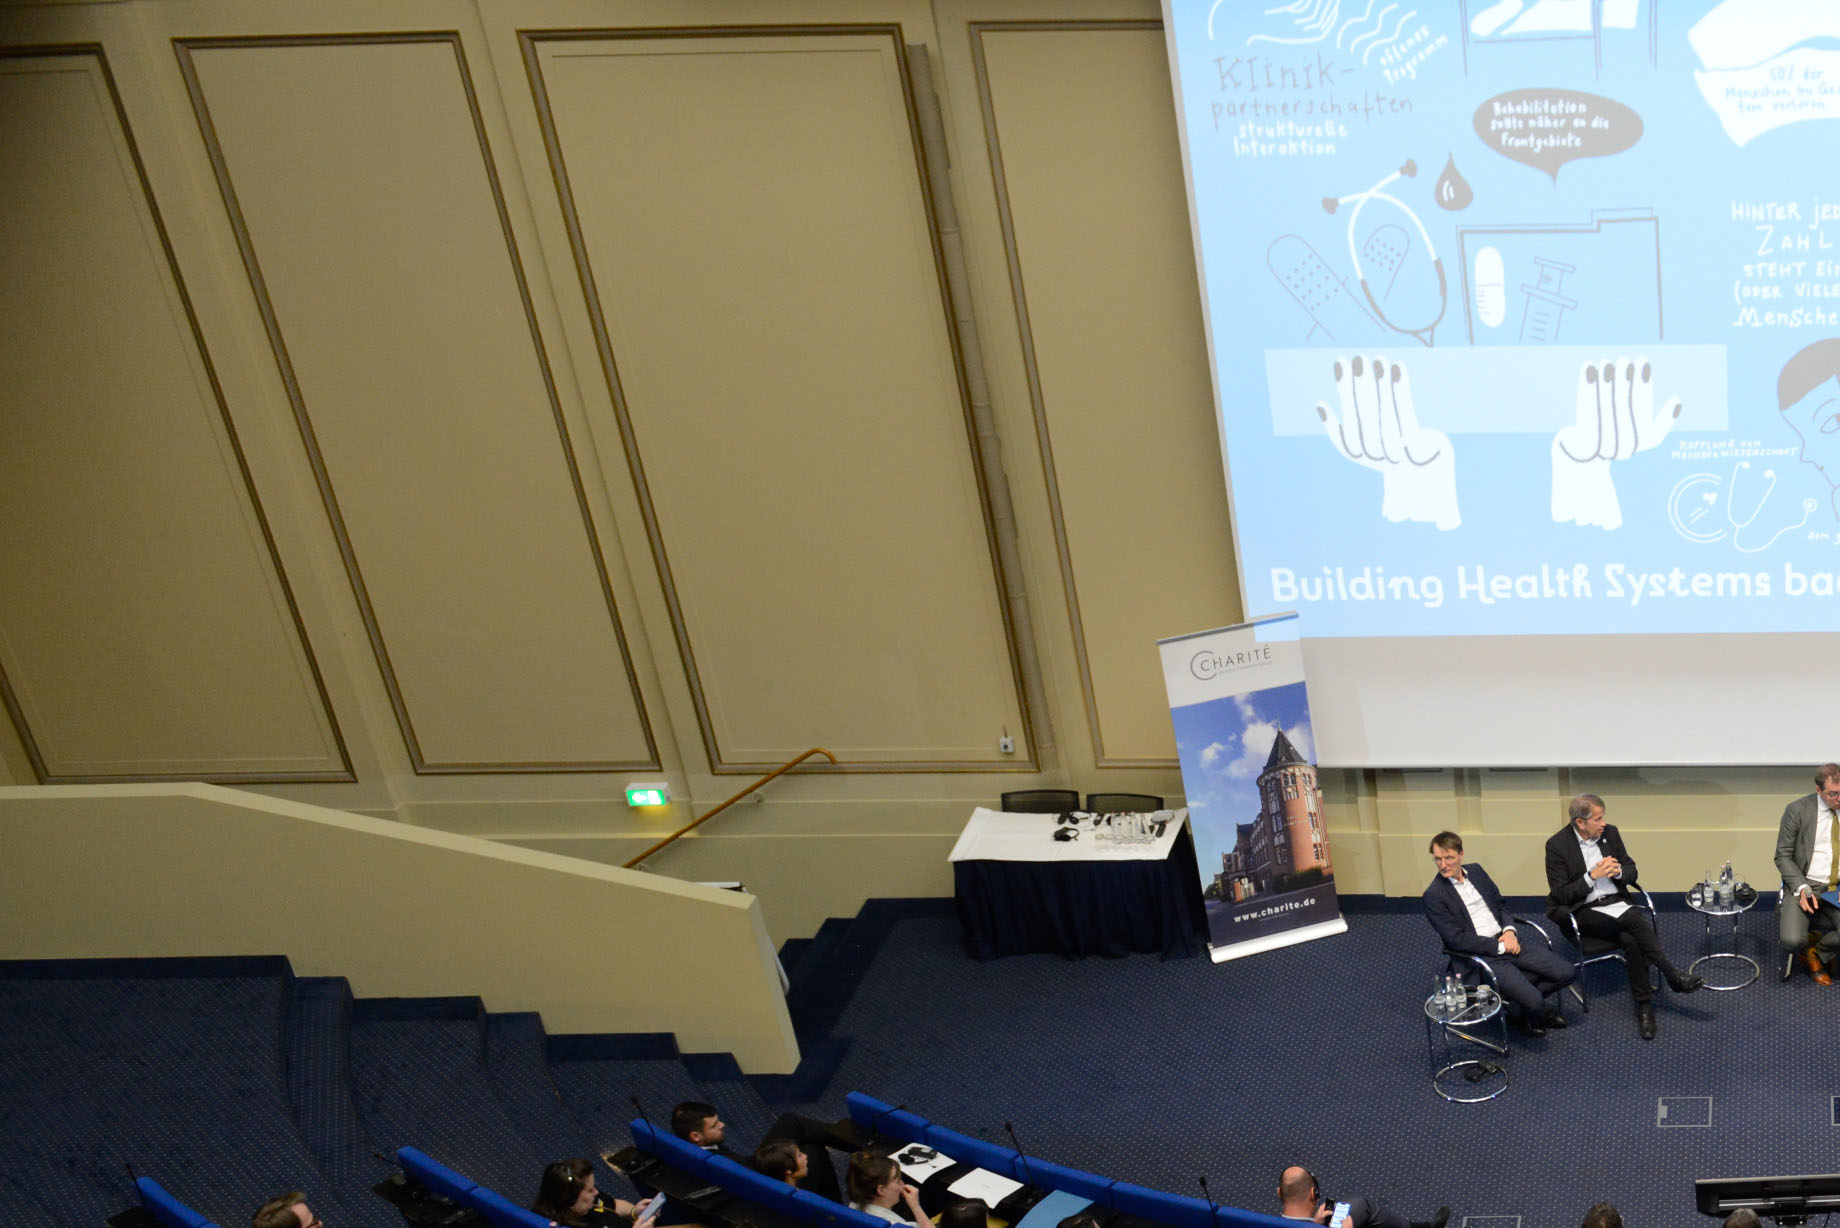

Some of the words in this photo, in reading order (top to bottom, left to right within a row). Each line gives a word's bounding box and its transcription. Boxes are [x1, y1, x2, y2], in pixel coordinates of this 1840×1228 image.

[1211, 51, 1357, 92] Klinik-
[1210, 90, 1414, 131] partnerschaften
[1492, 99, 1587, 116] Rehabilitation
[1238, 119, 1349, 137] strukturelle
[1591, 115, 1610, 130] die
[1234, 136, 1337, 156] Interaktion
[1501, 131, 1583, 153] Frontgebiete
[1731, 201, 1802, 222] HINTER
[1755, 224, 1835, 257] ZAHL
[1743, 262, 1807, 279] STEHT
[1734, 279, 1784, 305] (ODER
[1807, 528, 1830, 541] dem
[1269, 565, 1444, 608] Building
[1457, 564, 1593, 604] Health
[1605, 563, 1772, 606] Systems
[1198, 644, 1272, 674] CHARITÉ
[1233, 898, 1316, 923] www.charite.de
